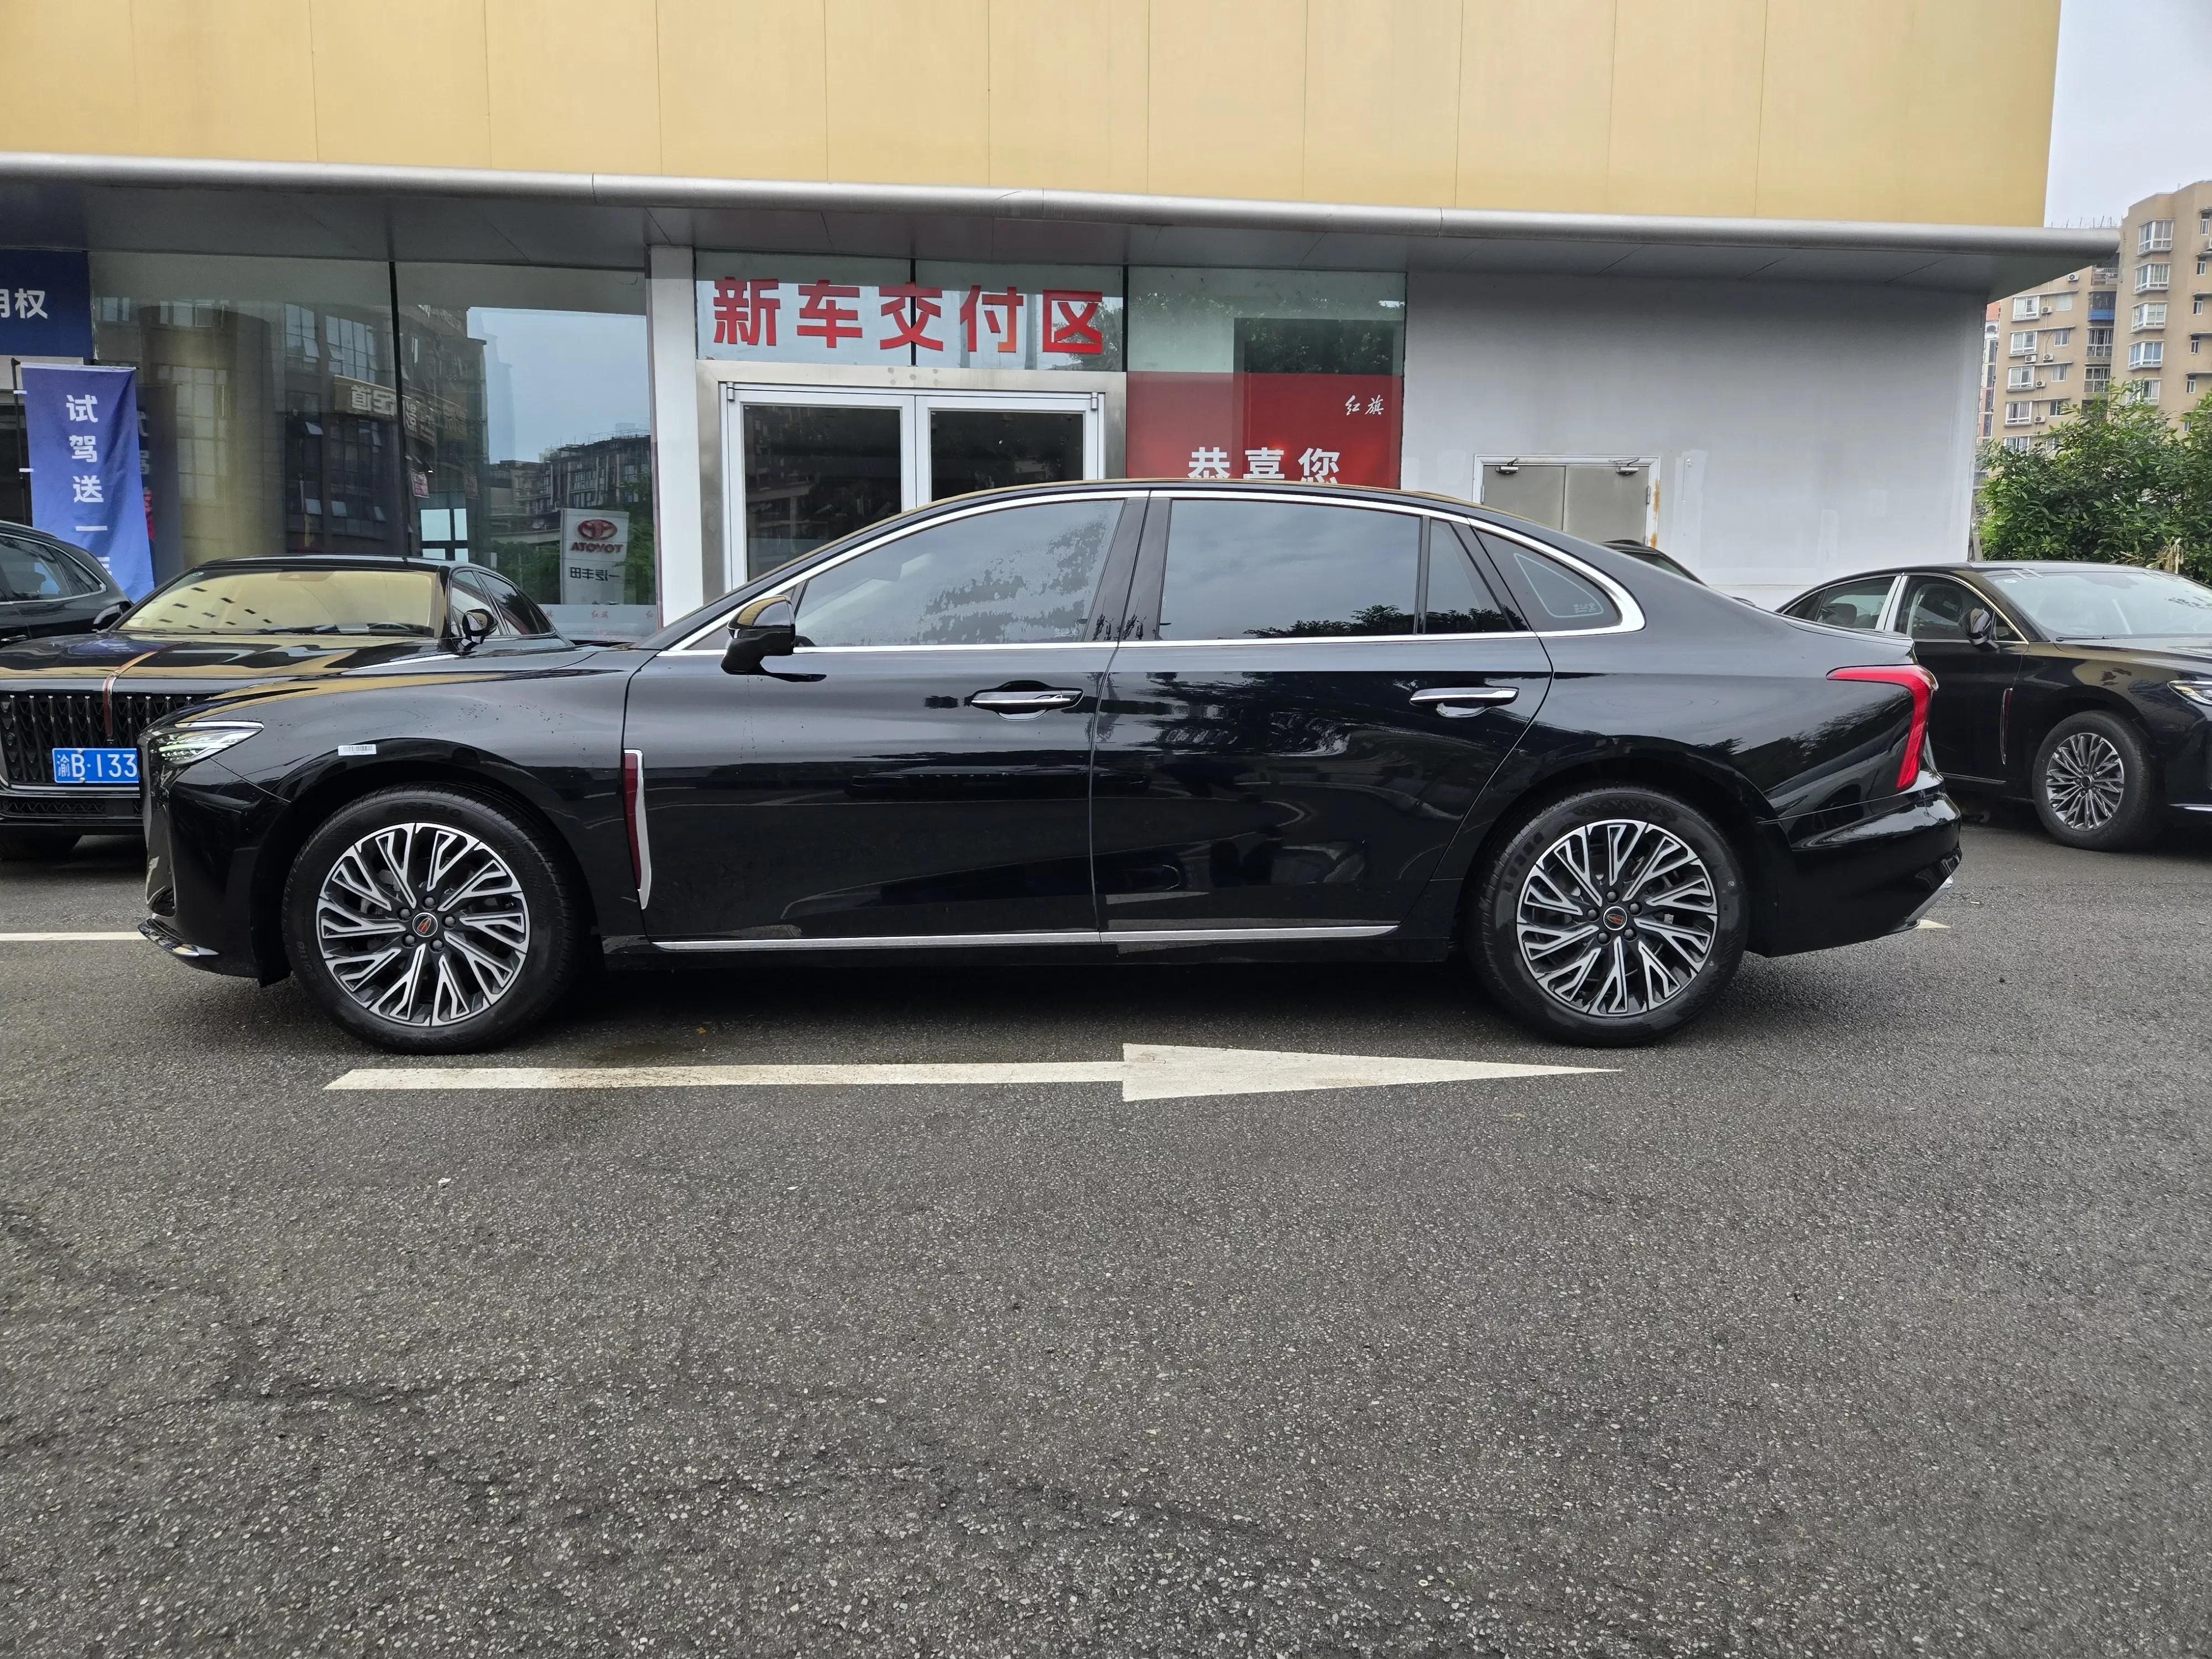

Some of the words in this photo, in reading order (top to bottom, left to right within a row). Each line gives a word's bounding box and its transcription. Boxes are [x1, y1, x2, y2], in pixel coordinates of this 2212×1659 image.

[713, 276, 1103, 354] 新车交付区
[1345, 394, 1384, 416] 红旗
[1188, 447, 1340, 484] 恭喜您
